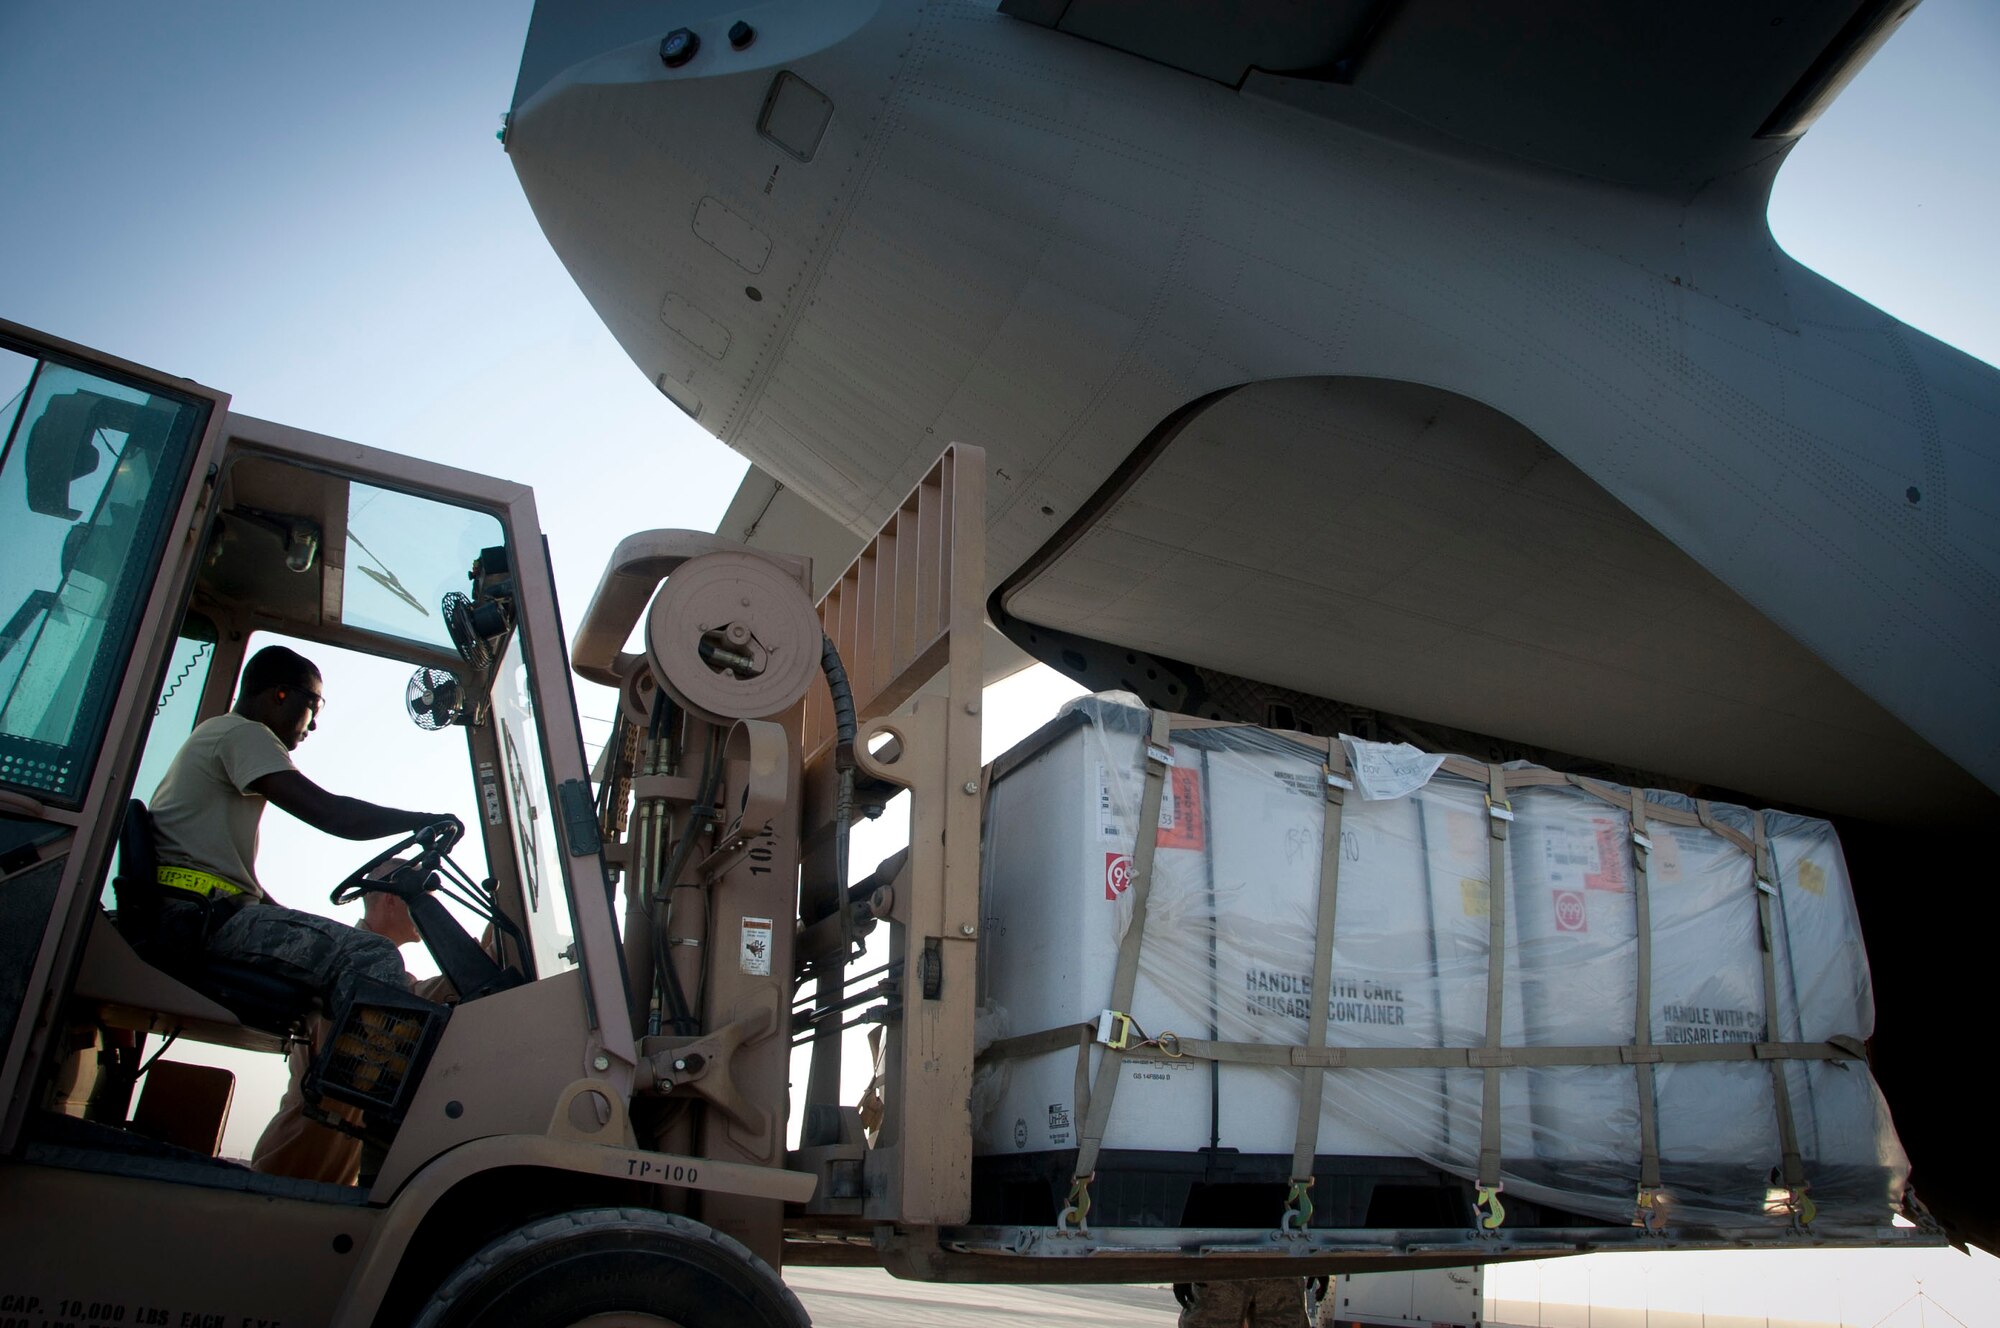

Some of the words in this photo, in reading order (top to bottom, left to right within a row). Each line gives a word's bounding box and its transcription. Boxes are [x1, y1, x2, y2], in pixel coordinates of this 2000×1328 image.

[1560, 902, 1581, 920] 999
[1246, 967, 1312, 995] HANDLE
[1332, 977, 1358, 1000] ITH
[1328, 1001, 1405, 1026] CONTAINER
[1663, 1005, 1711, 1025] HANDLE
[1713, 1008, 1744, 1028] WITH
[1664, 1026, 1719, 1044] REUSABLE
[627, 1159, 698, 1184] TP-100
[1, 1295, 44, 1314] CAP.
[60, 1300, 125, 1324] 10,000
[136, 1307, 170, 1326] LBS
[181, 1312, 225, 1328] EACH
